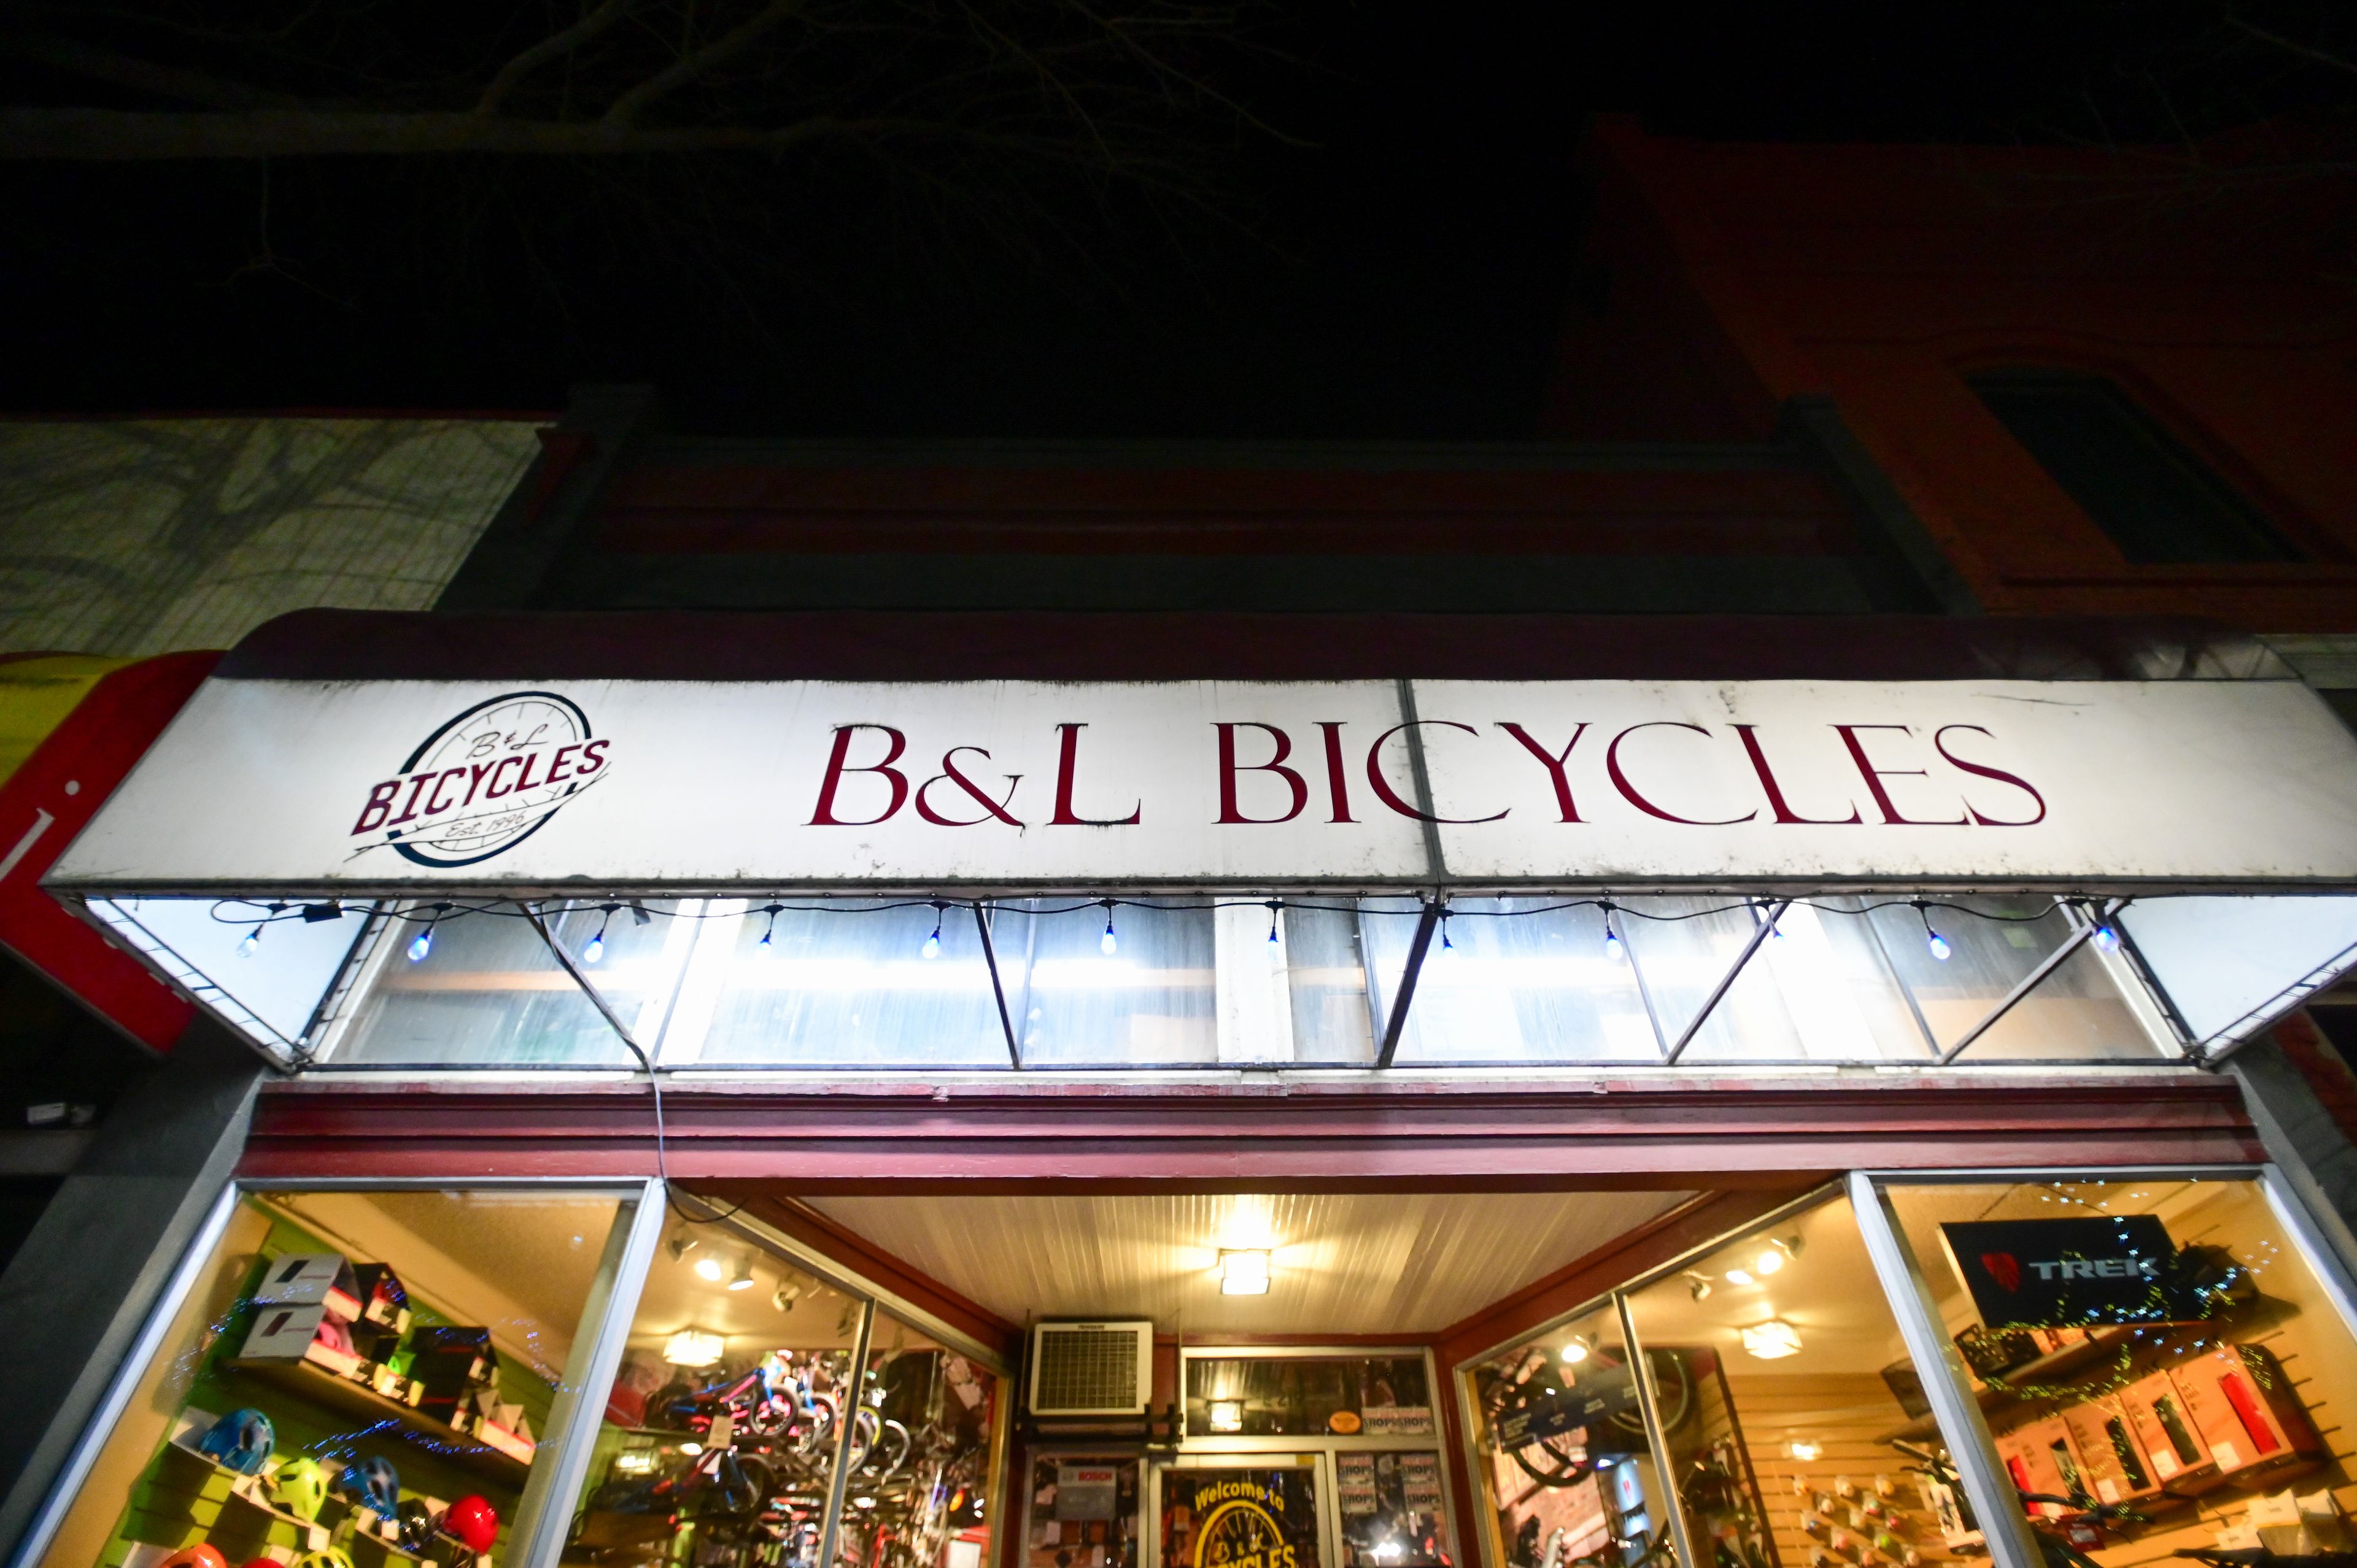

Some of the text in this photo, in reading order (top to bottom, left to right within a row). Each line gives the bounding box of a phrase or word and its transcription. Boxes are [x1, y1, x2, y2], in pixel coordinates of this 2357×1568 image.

[350, 739, 611, 837] BICYCLES
[800, 720, 2047, 827] B&L BICYCLES
[486, 810, 526, 832] 1996
[2028, 1257, 2161, 1281] TREK
[1195, 1481, 1285, 1512] Welcome to
